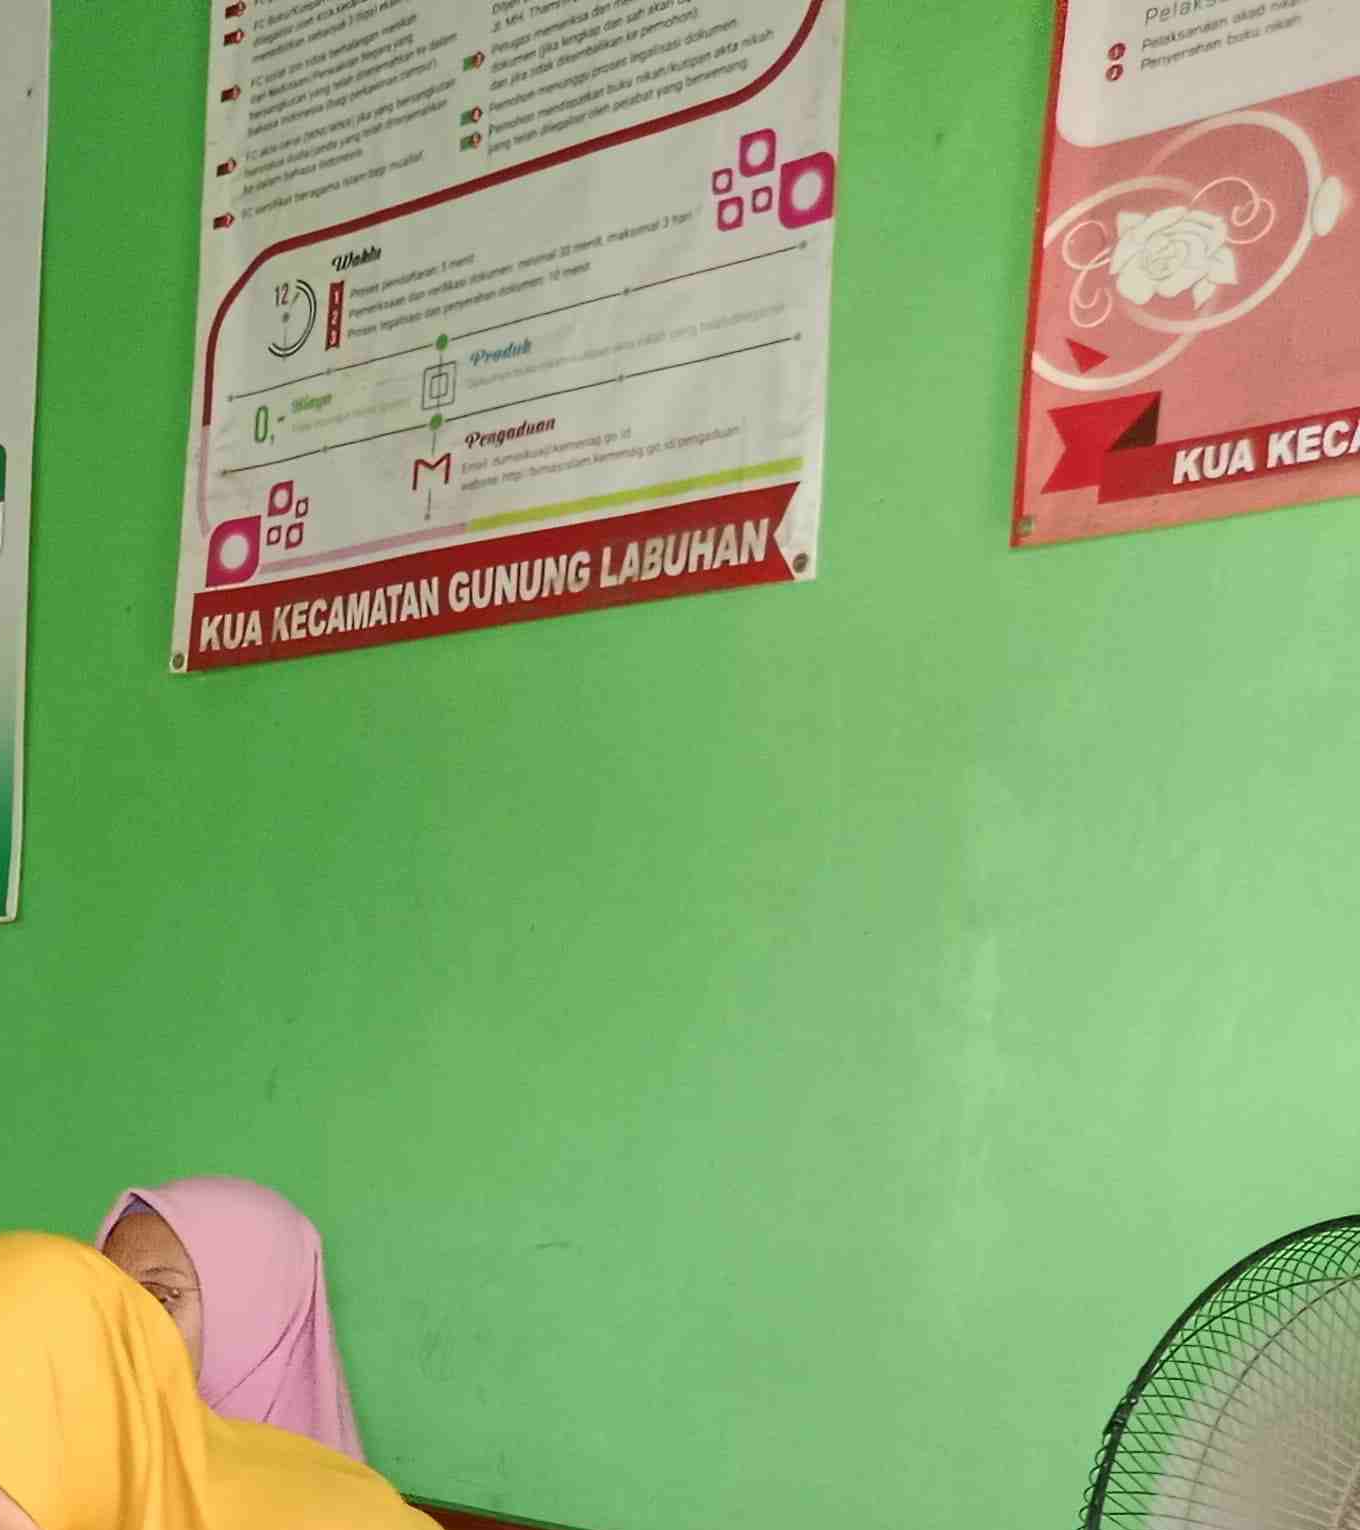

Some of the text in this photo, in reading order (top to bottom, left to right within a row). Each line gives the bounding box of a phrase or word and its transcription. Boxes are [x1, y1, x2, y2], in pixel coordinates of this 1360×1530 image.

[465, 417, 556, 449] Pengaduan
[1172, 443, 1256, 486] KUA
[201, 518, 772, 653] KUA KECAMATAN GUNUNG LABUHAN
